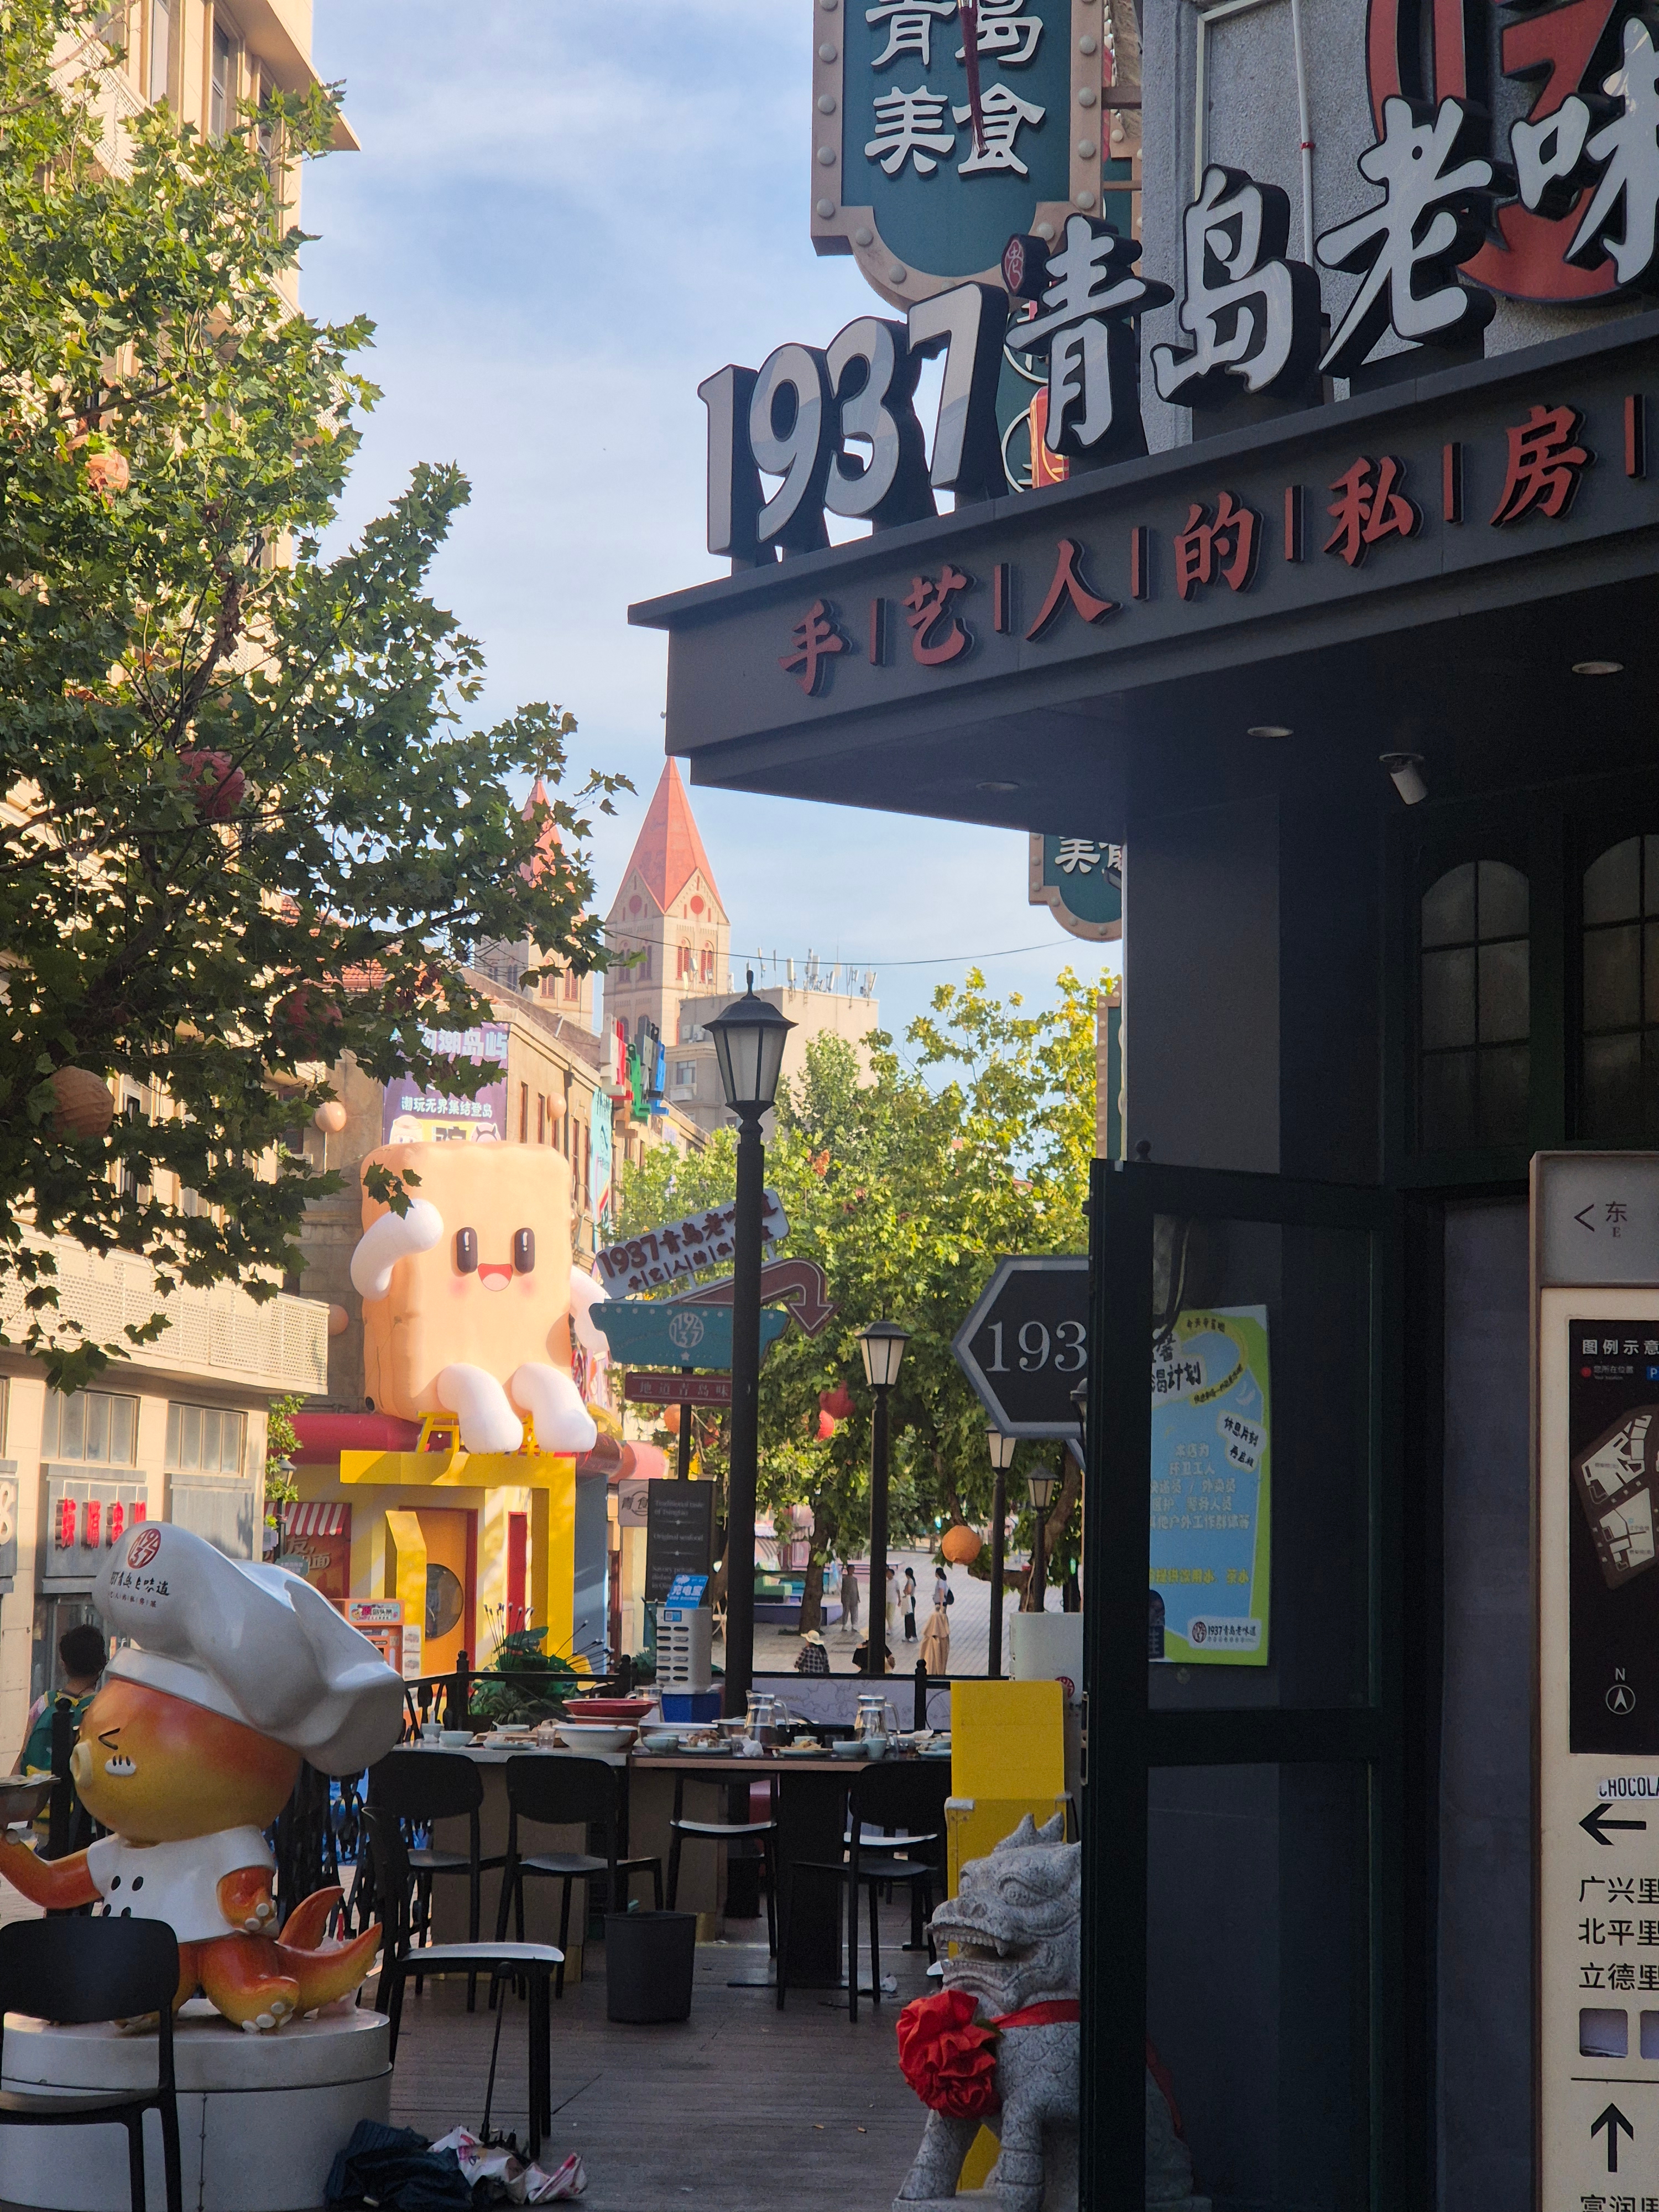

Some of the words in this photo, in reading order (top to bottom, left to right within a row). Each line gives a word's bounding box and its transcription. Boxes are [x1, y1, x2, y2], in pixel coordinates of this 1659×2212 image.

[865, 0, 1044, 66] 青岛
[864, 82, 1046, 175] 美食
[401, 1095, 492, 1119] 潮玩无界集结登岛
[1605, 1201, 1627, 1223] 东
[1613, 1227, 1621, 1238] E
[1582, 1339, 1659, 1355] 图例示意
[1615, 1668, 1626, 1681] N
[1578, 1875, 1659, 1904] 广兴里
[1578, 1917, 1659, 1947] 北平里
[1578, 1961, 1659, 1991] 立德里
